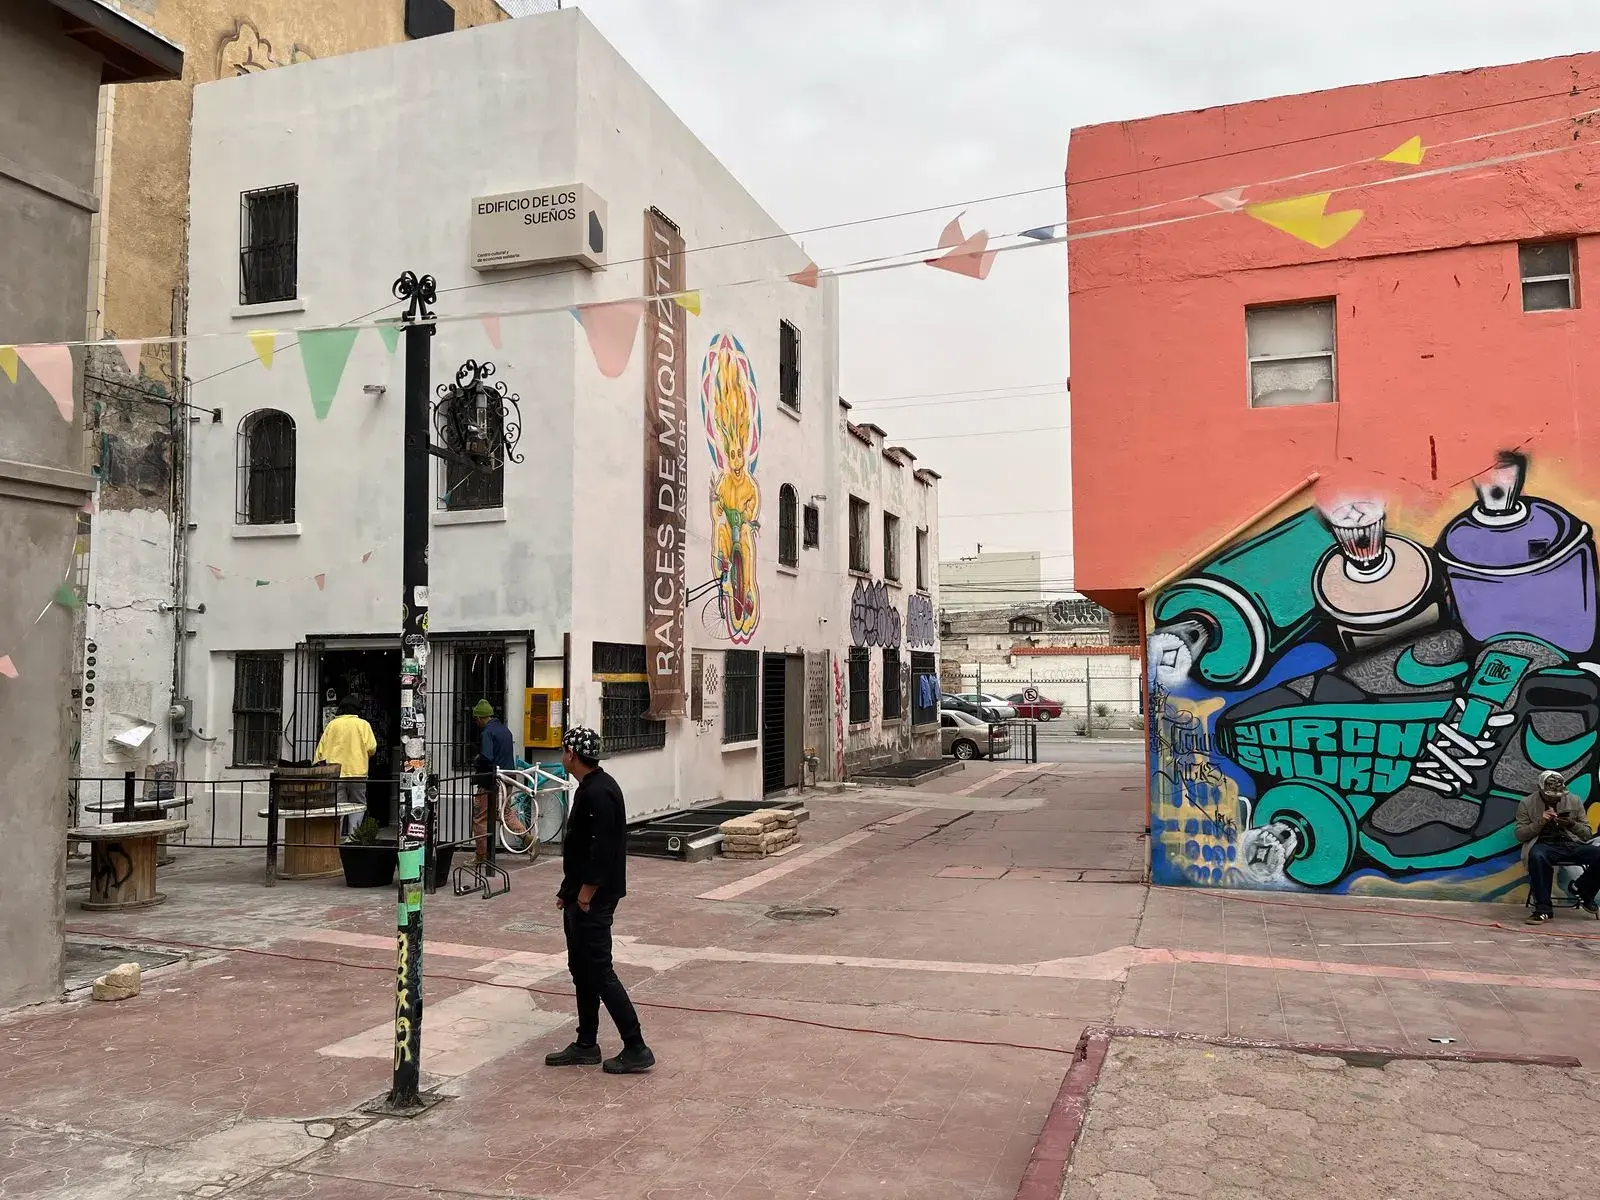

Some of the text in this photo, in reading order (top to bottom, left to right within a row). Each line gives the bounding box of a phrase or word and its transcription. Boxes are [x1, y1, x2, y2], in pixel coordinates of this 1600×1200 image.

[478, 192, 576, 214] EDIFICIO DE LOS
[524, 208, 576, 225] SUEÑOS
[654, 231, 676, 448] MIQUIZTLI
[658, 455, 676, 513] DE
[650, 523, 675, 675] RAÍCES
[1237, 744, 1412, 793] SHUKY
